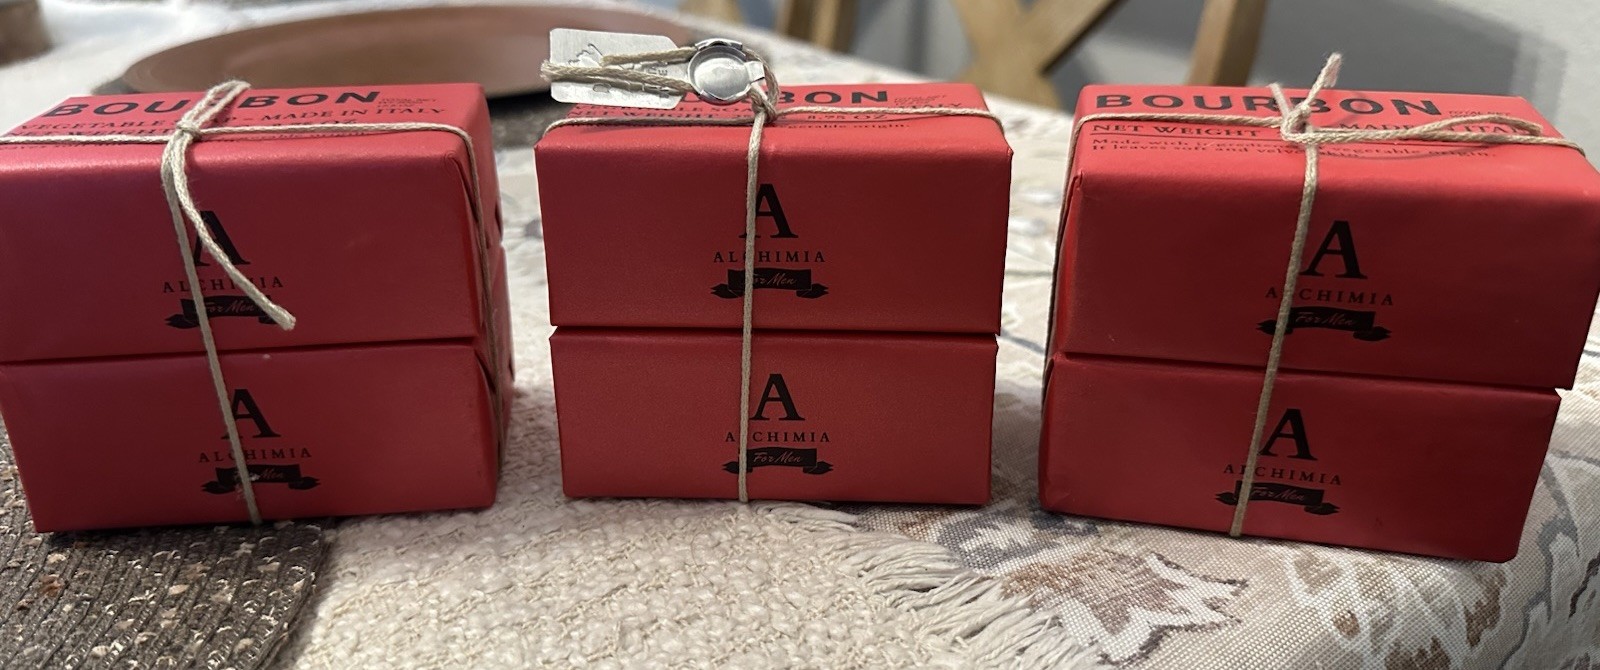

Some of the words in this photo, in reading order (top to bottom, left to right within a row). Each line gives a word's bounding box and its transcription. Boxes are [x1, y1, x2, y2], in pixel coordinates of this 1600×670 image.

[42, 91, 380, 117] BOUBON
[1096, 94, 1441, 116] BOURBON
[21, 119, 164, 130] VEGETABLE
[261, 109, 332, 121] MADE
[341, 108, 369, 117] IN
[374, 106, 446, 115] ITALY
[1093, 124, 1144, 133] NET
[1152, 126, 1261, 138] WEIGHT
[739, 183, 799, 239] A
[193, 210, 251, 267] A
[1298, 220, 1368, 280] A
[713, 251, 826, 263] ALHIMIA
[767, 272, 798, 287] Men
[1264, 286, 1394, 306] ACHIMIA
[748, 373, 806, 421] A
[220, 388, 282, 440] A
[725, 431, 831, 443] ACHIMIA
[1257, 407, 1319, 461] A
[752, 451, 775, 463] For
[774, 450, 803, 464] Men
